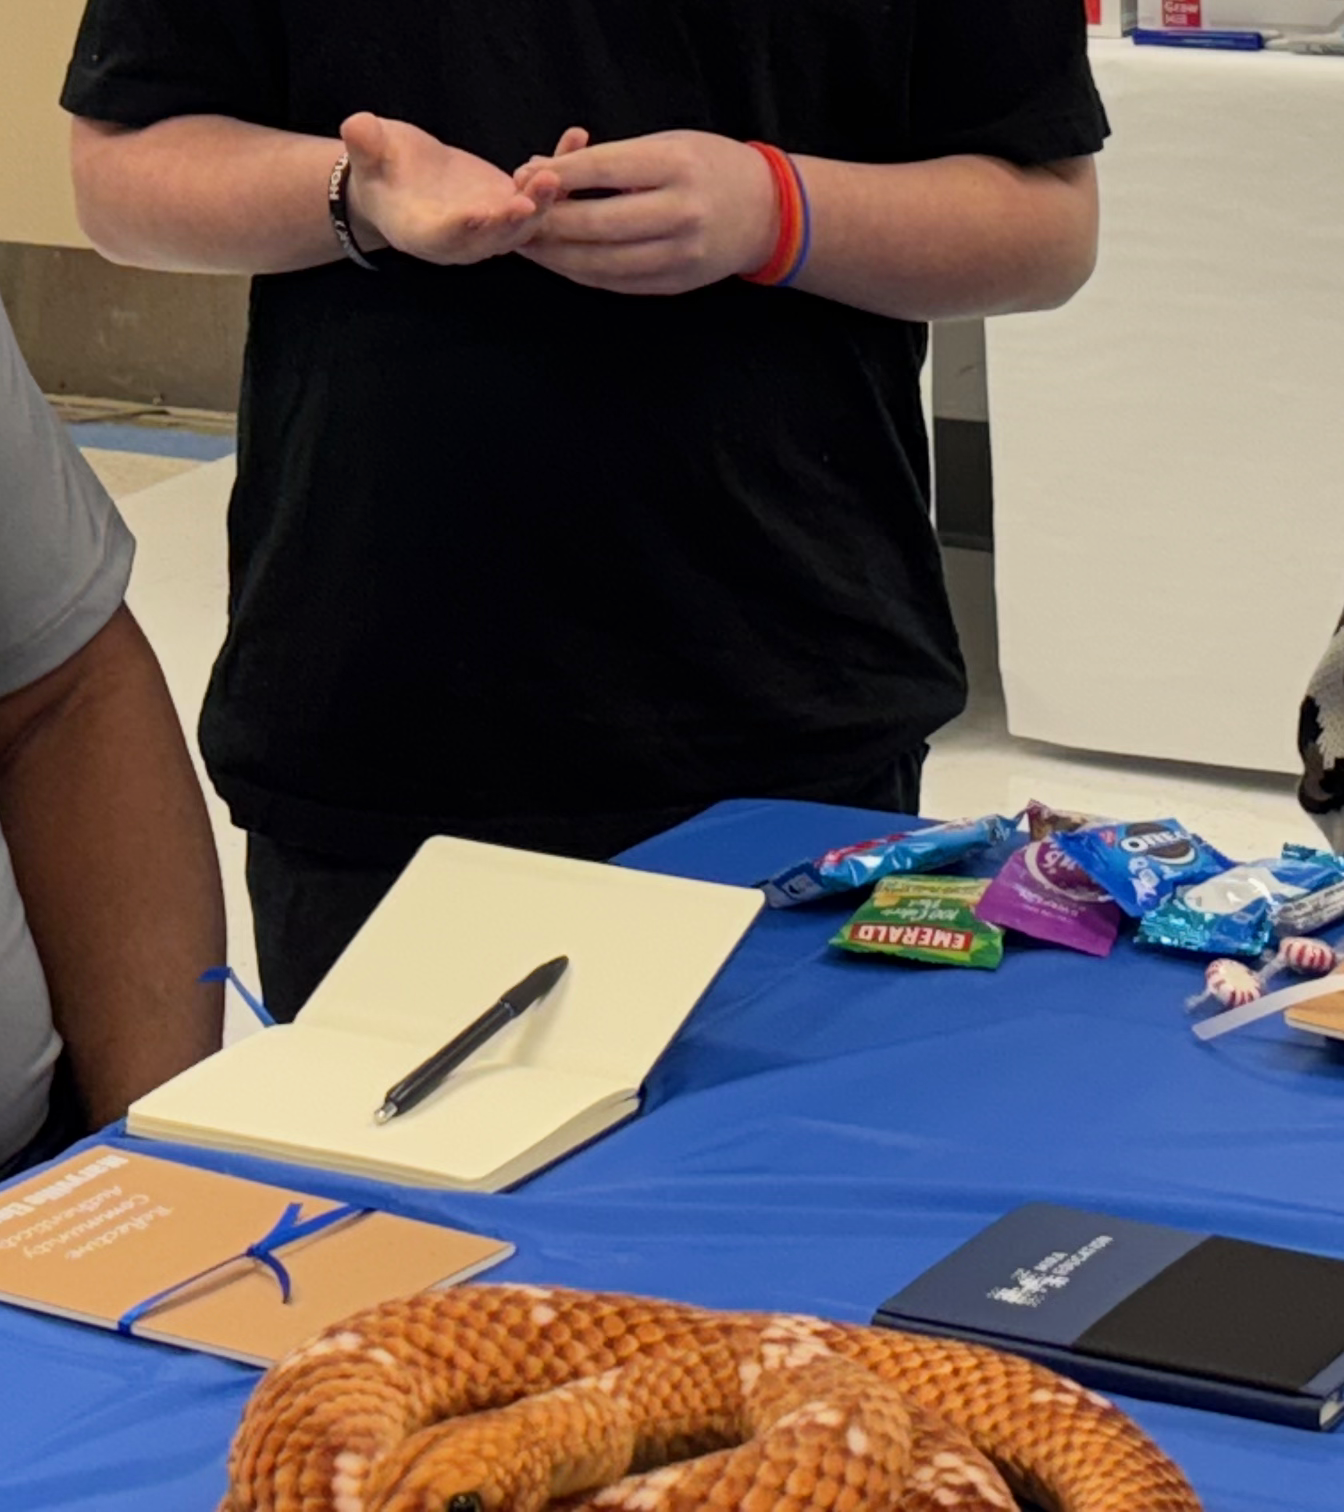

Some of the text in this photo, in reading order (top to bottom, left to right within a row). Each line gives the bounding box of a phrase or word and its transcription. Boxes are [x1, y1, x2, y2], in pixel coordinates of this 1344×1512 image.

[857, 923, 965, 950] EMERALD
[23, 1153, 129, 1206] Maryville
[23, 1193, 150, 1259] Community
